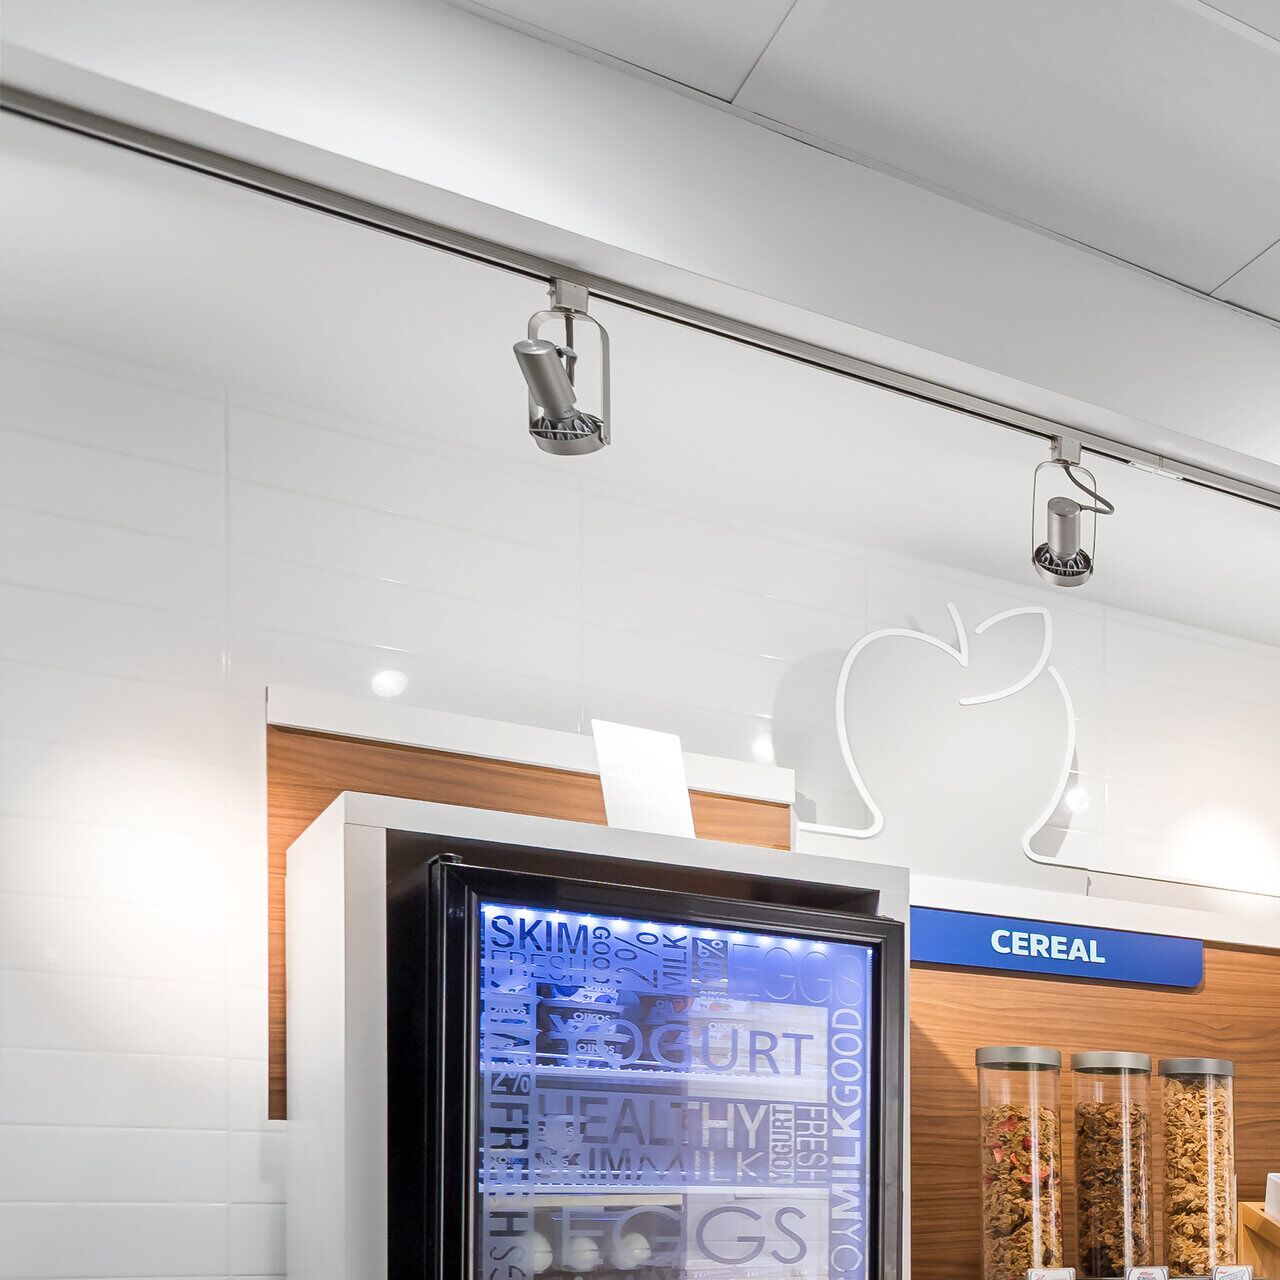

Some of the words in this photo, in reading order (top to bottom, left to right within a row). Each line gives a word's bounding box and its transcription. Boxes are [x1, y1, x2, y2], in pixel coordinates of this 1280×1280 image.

[491, 915, 588, 956] SKIM
[662, 933, 688, 990] MILK
[991, 929, 1106, 964] CEREAL
[732, 943, 864, 1006] EGGS
[550, 1013, 814, 1076] YOGURT
[831, 1008, 863, 1107] GOOD
[493, 1072, 530, 1094] 2%
[537, 1094, 769, 1150] HEALTHY
[770, 1105, 793, 1183] YOGURT
[796, 1105, 828, 1184] FRESH
[831, 1108, 863, 1221] MILK
[562, 1205, 808, 1268] EGGS
